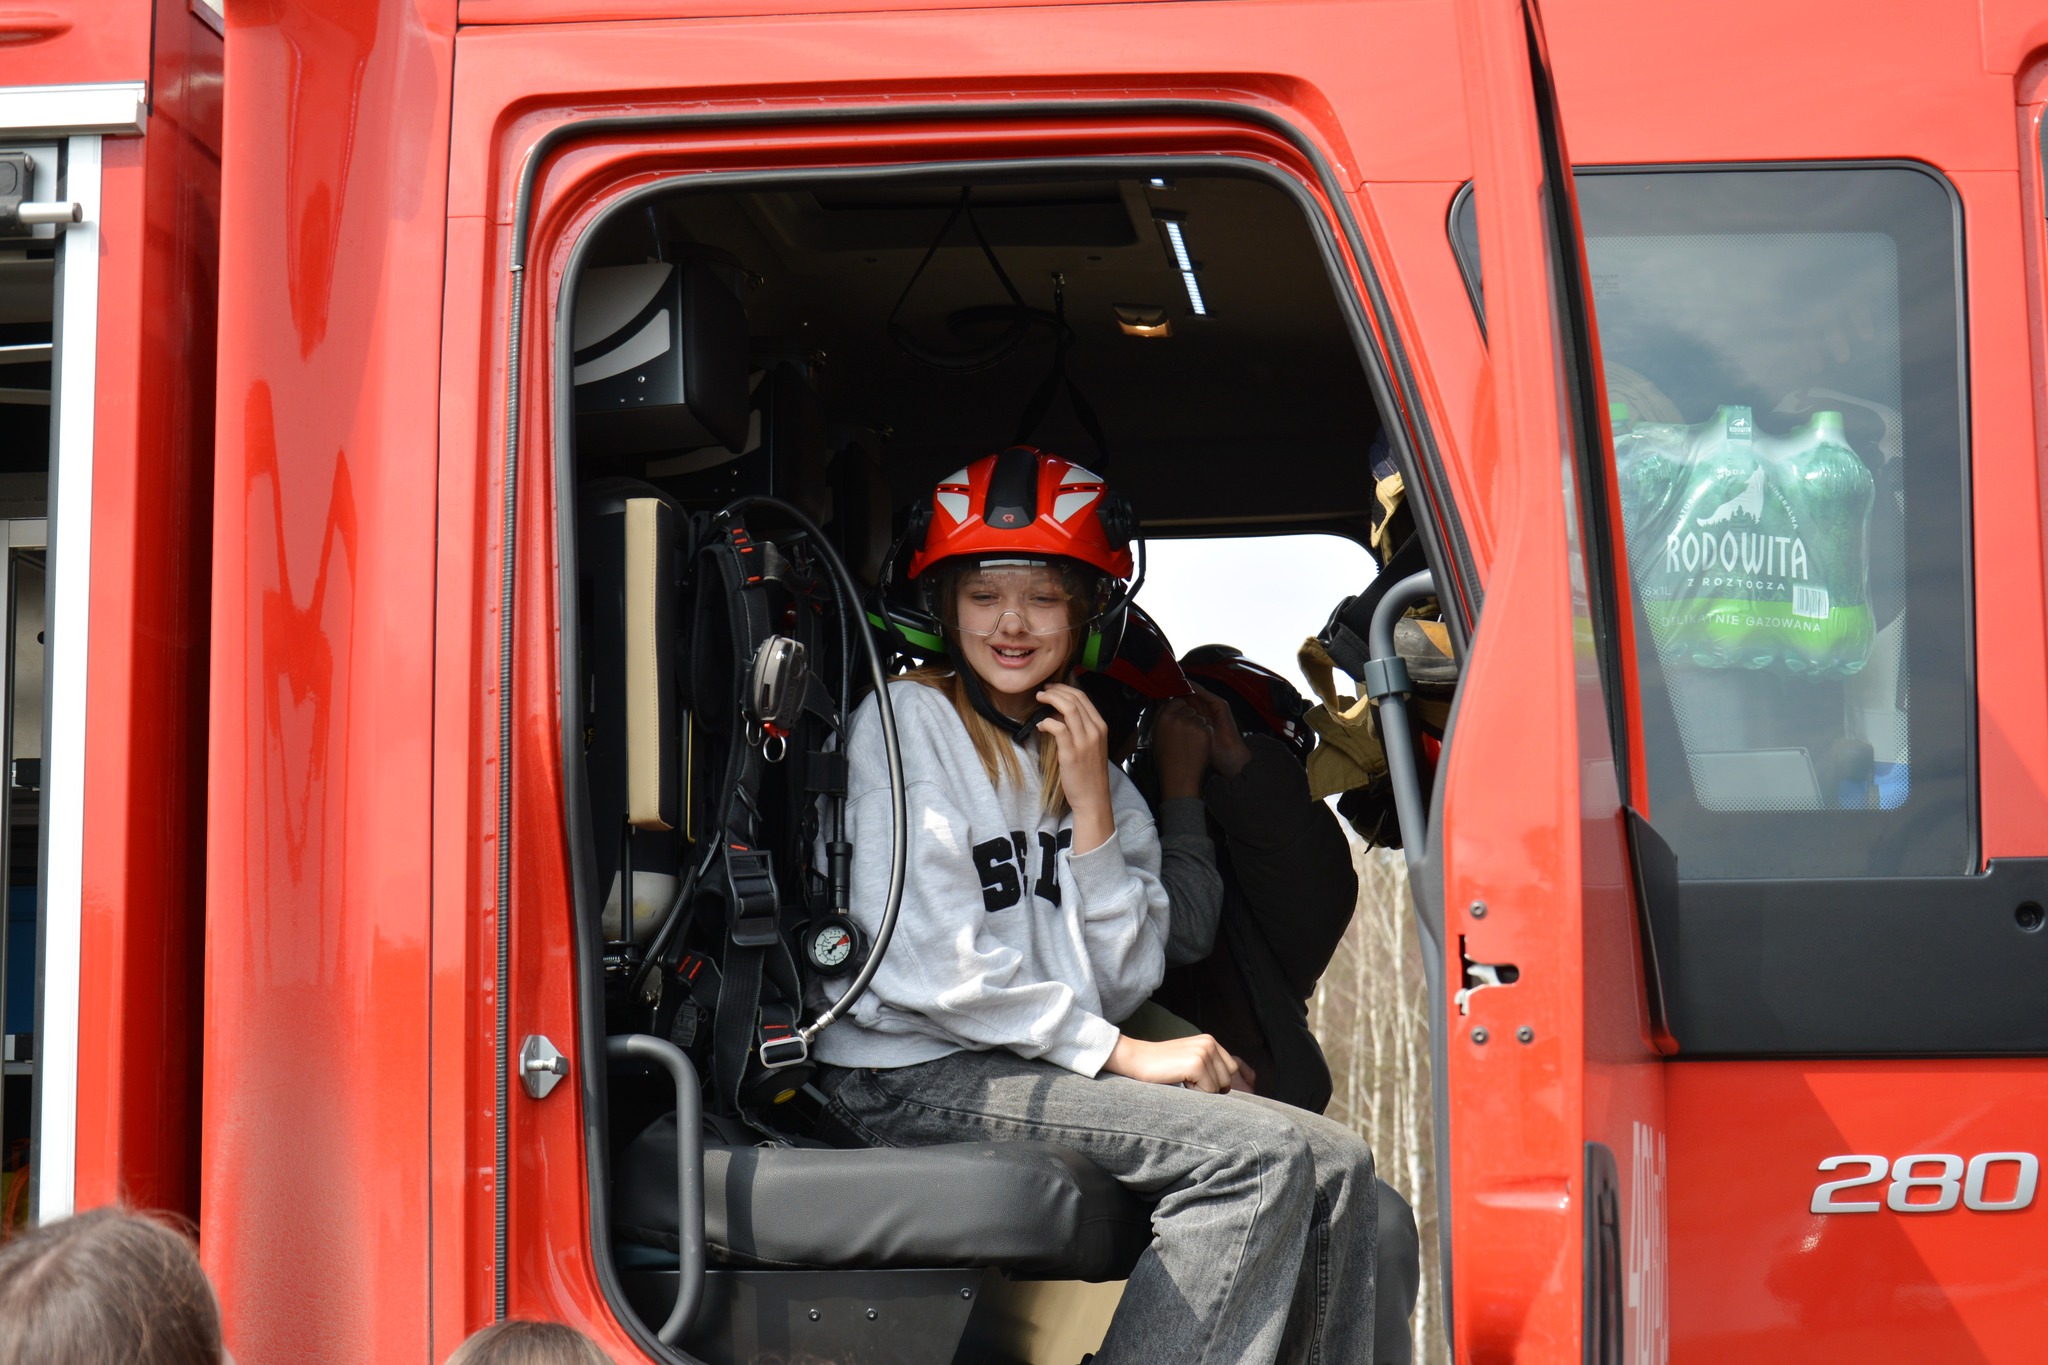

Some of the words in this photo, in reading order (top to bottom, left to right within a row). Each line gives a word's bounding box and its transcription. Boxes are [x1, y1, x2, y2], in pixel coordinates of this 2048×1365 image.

[1715, 468, 1746, 480] WODA
[1666, 530, 1808, 579] RODOWITA
[1687, 578, 1695, 587] Z
[1702, 577, 1786, 591] ROZTOCZA
[1662, 613, 1740, 627] DELIKATNIE
[1746, 615, 1821, 633] GAZOWANA
[1810, 1152, 2039, 1214] 280
